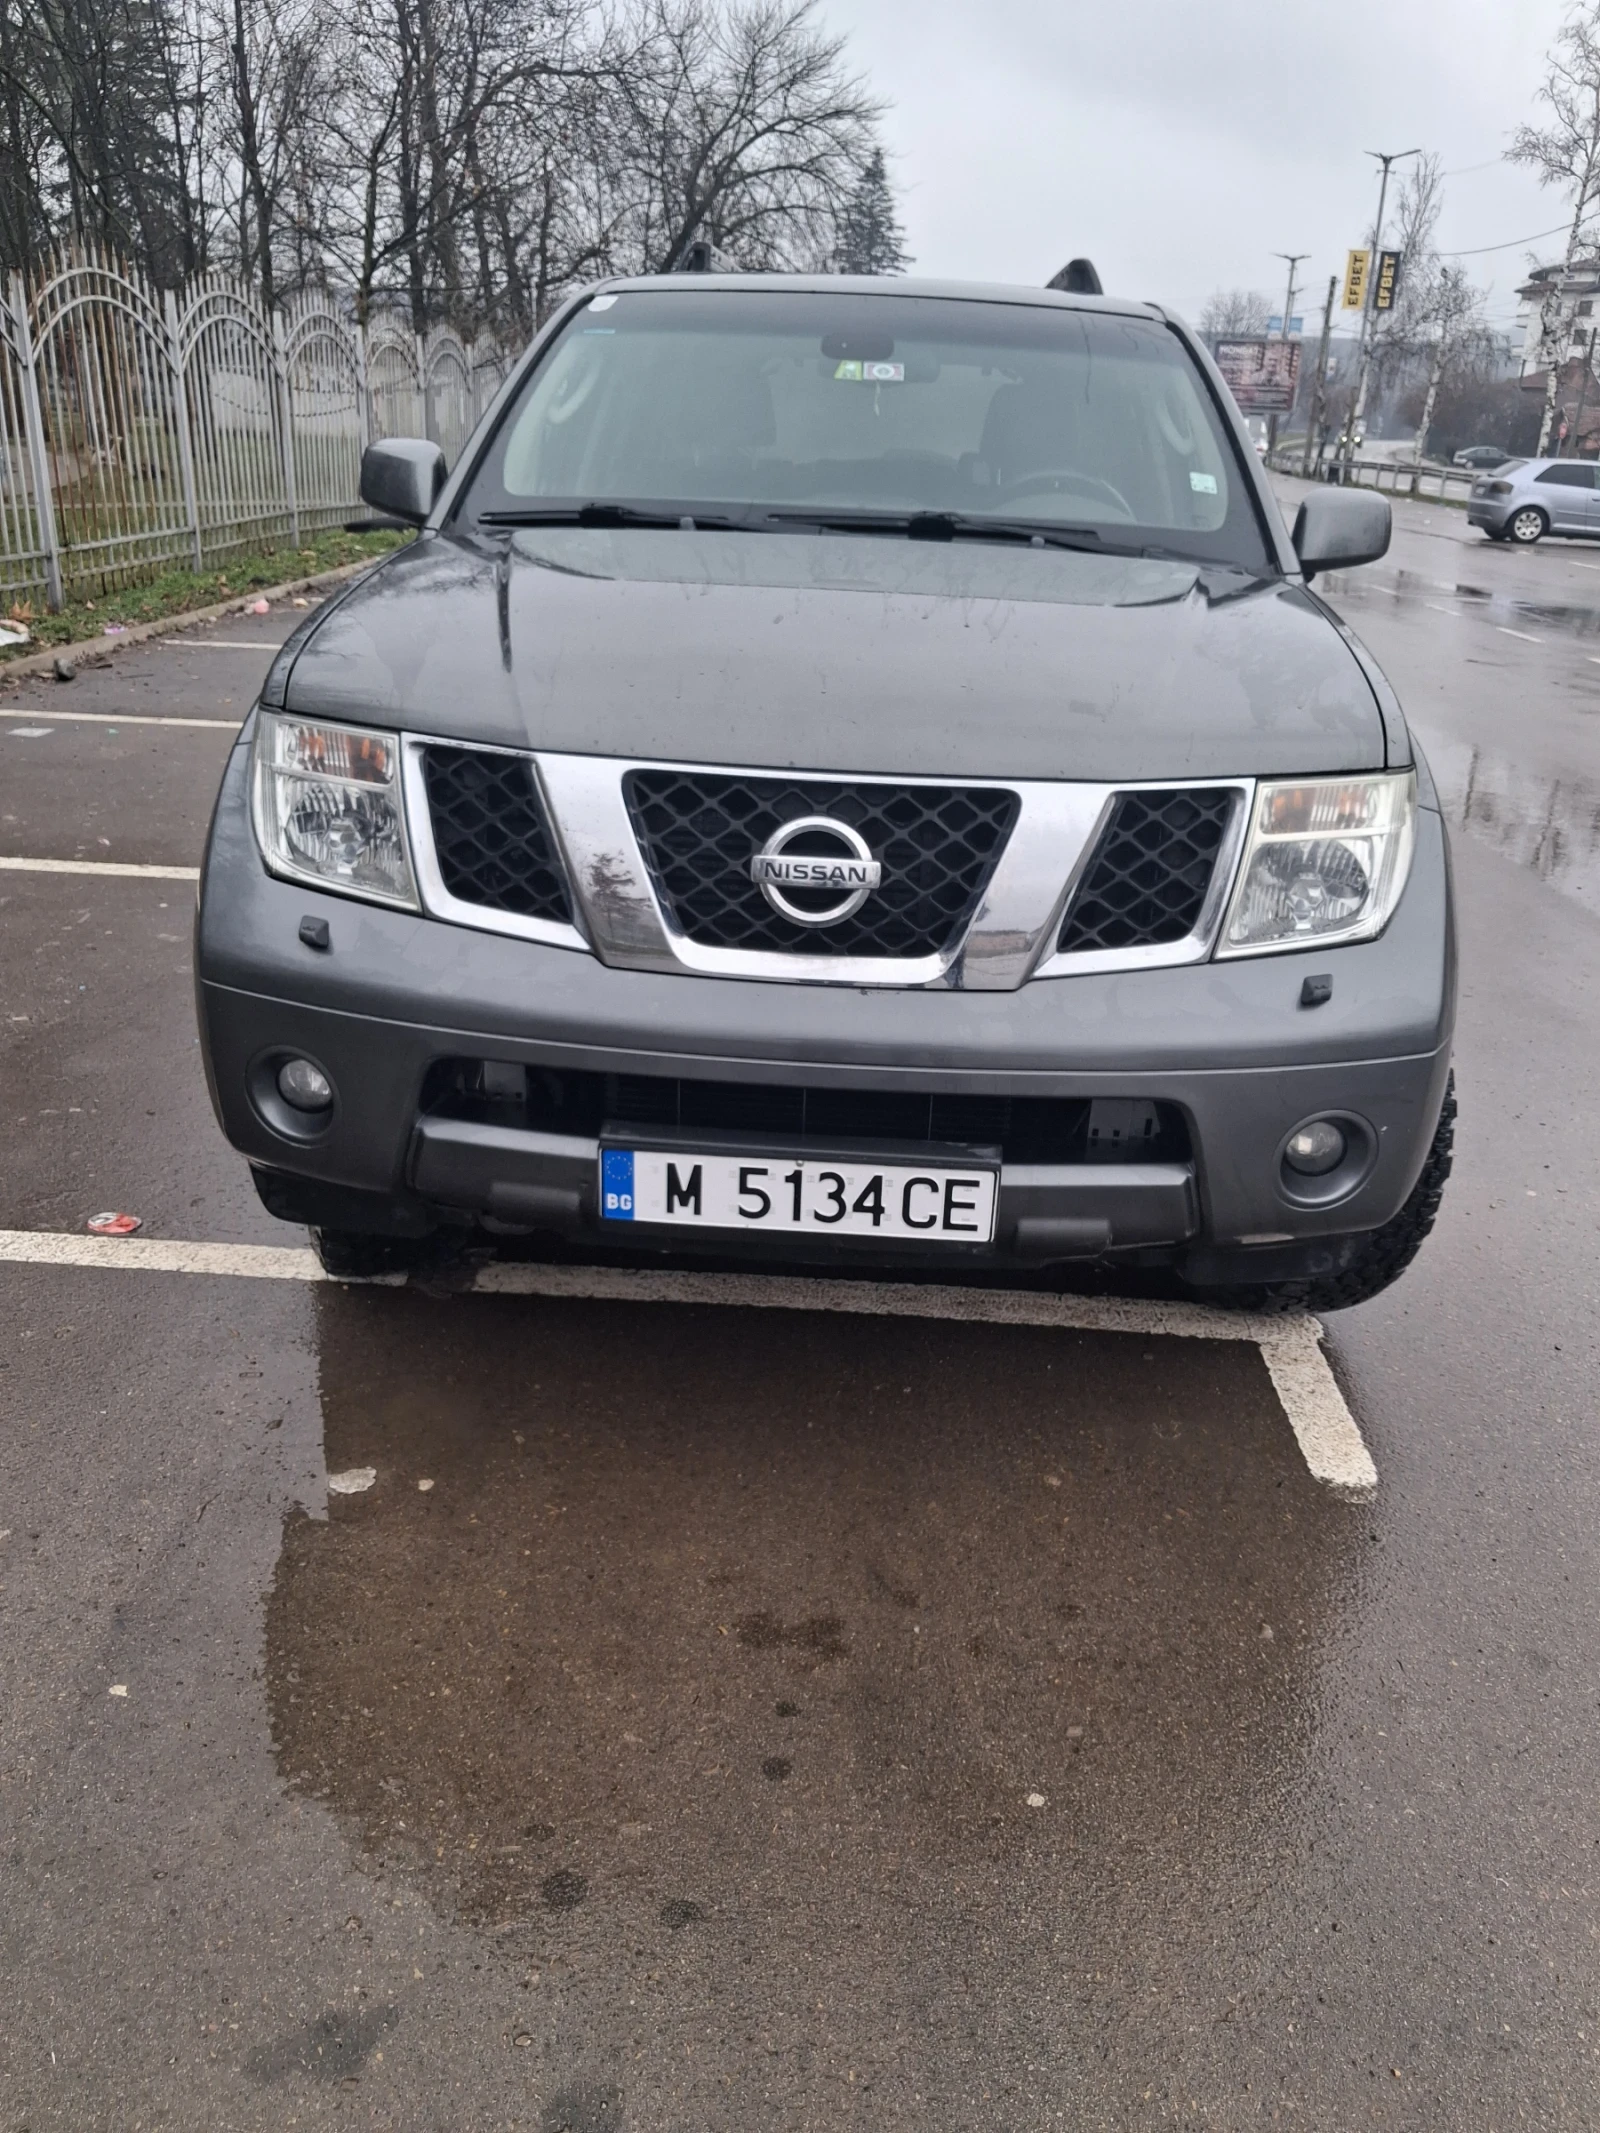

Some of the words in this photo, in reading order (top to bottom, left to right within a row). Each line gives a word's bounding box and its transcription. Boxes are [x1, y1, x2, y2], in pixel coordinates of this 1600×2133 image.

[1348, 254, 1364, 306] EFBET
[1377, 255, 1395, 308] EFBET
[764, 862, 866, 883] NISSAN
[607, 1193, 632, 1211] BG
